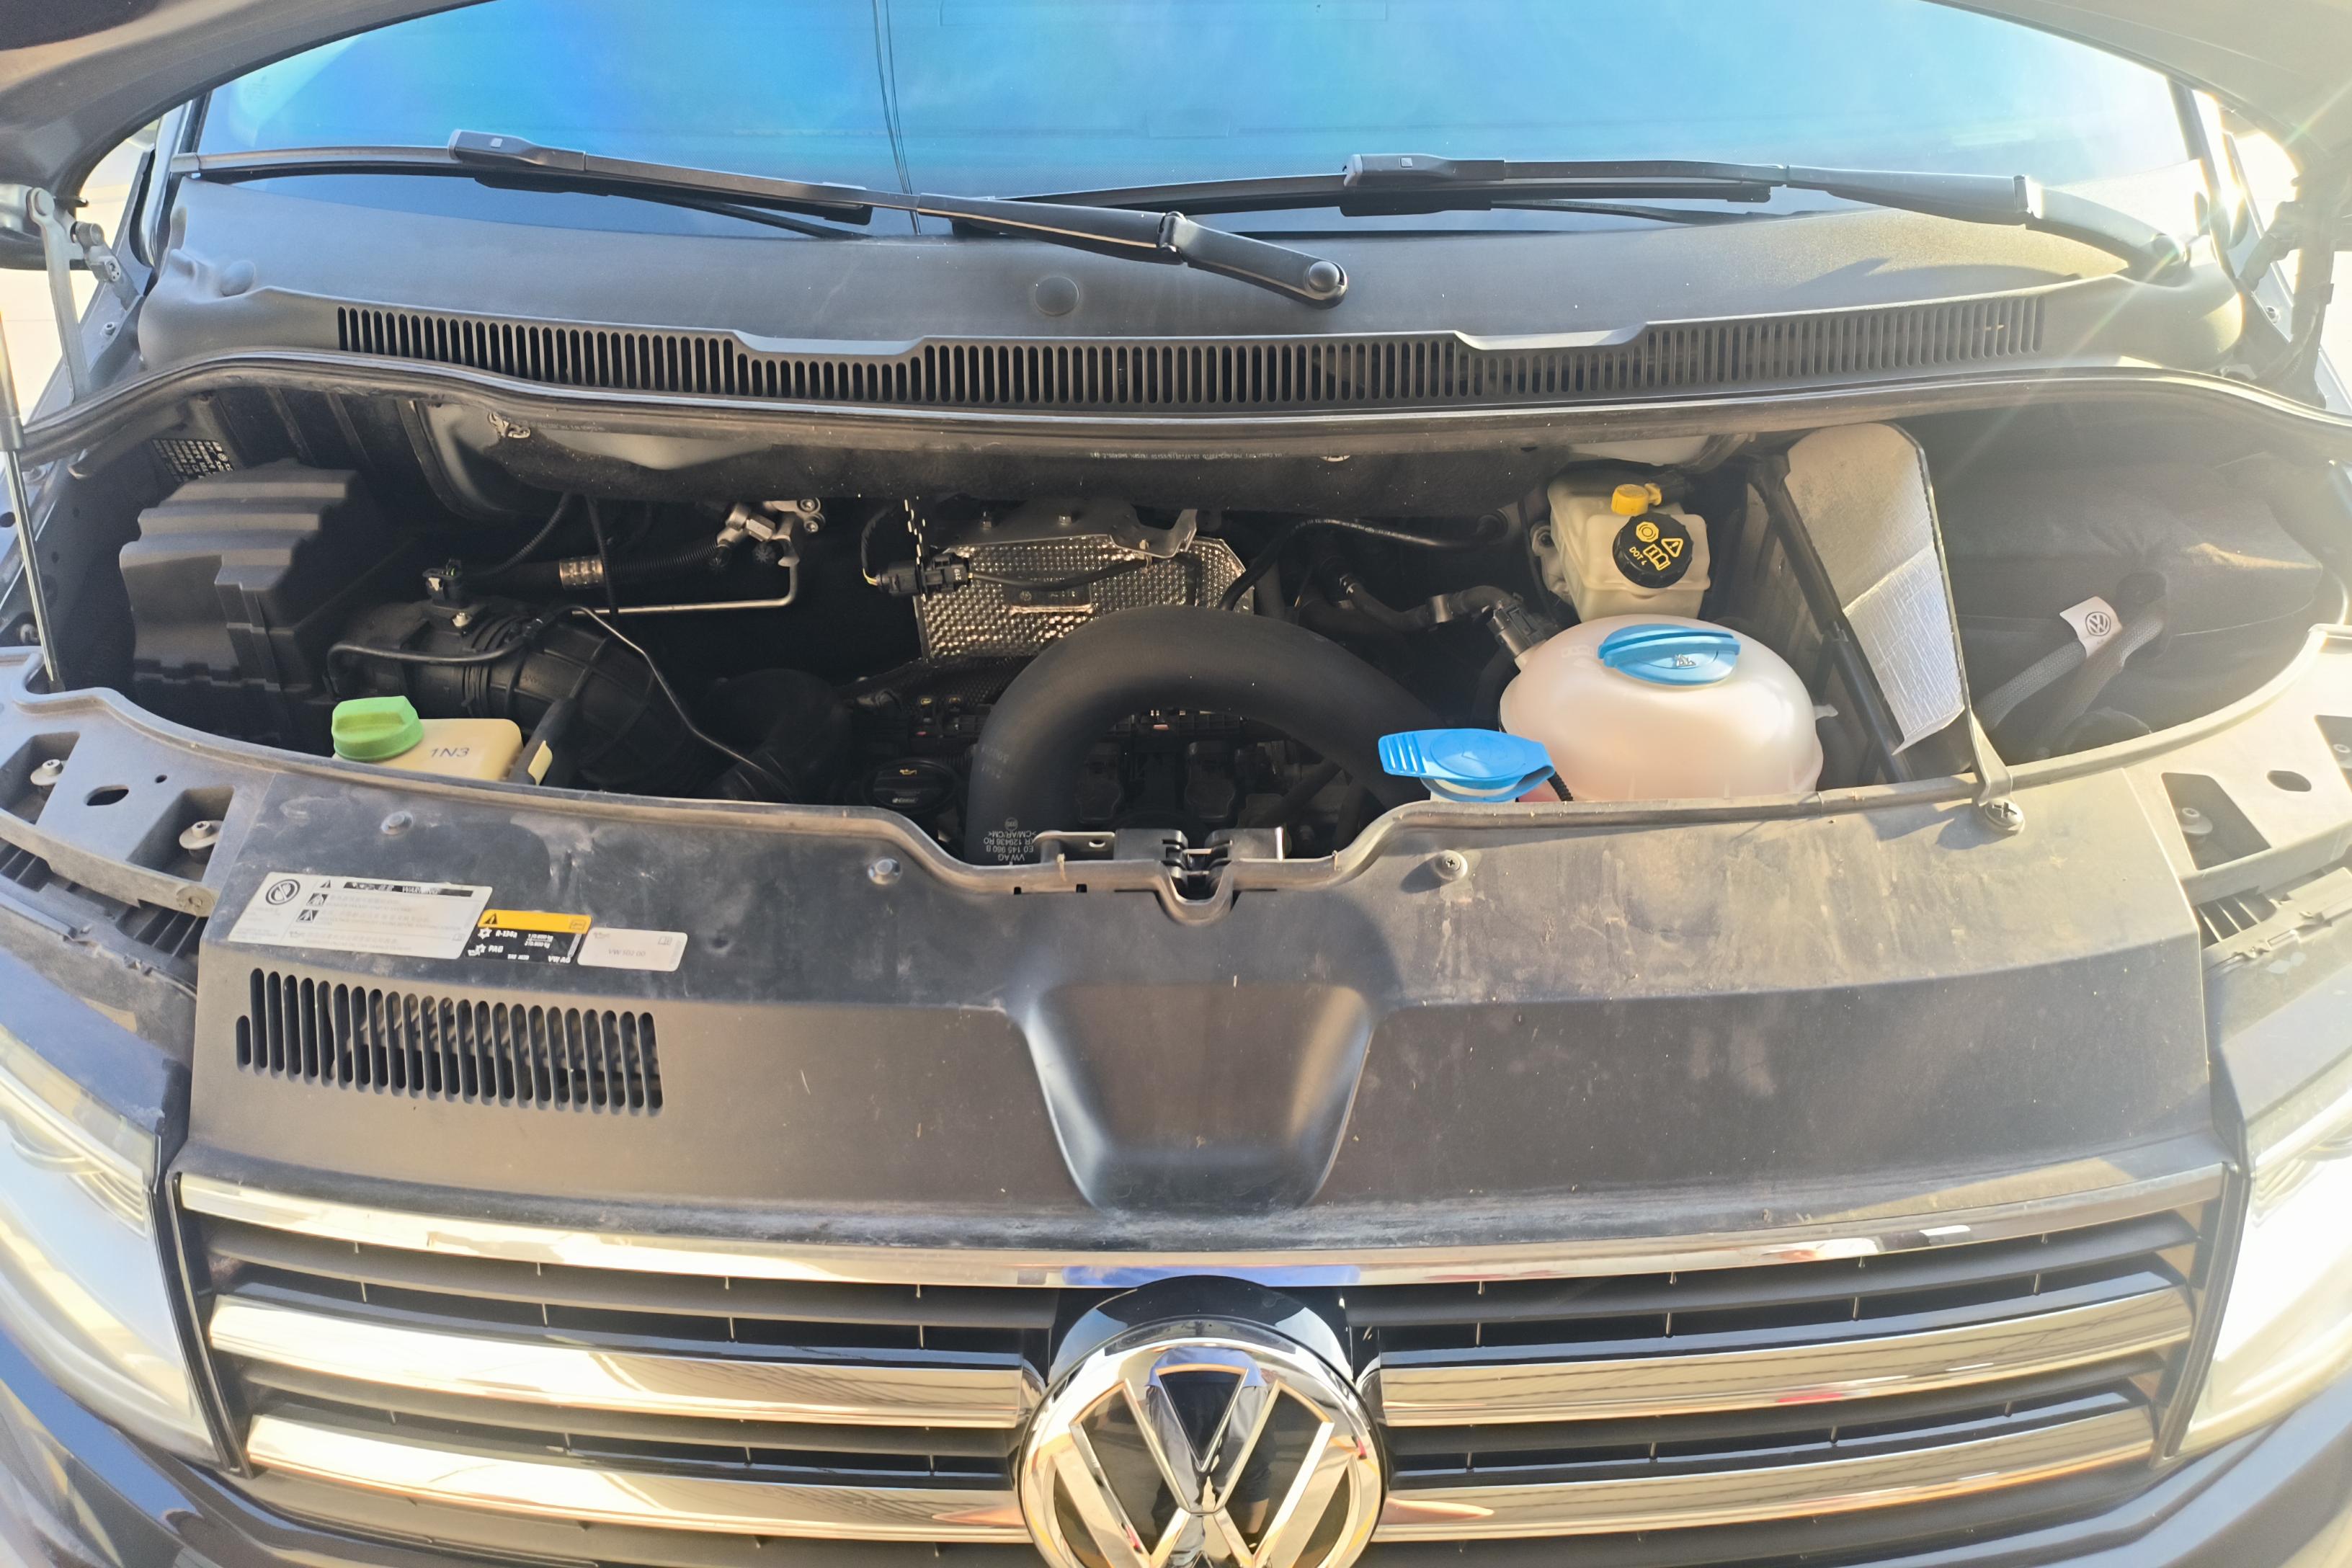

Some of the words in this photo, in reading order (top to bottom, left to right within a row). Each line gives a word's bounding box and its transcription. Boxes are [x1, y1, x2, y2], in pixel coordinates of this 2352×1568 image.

[1629, 546, 1644, 560] DOT
[432, 747, 470, 757] 1N3
[495, 930, 517, 938] R-134a
[489, 945, 504, 953] PAG
